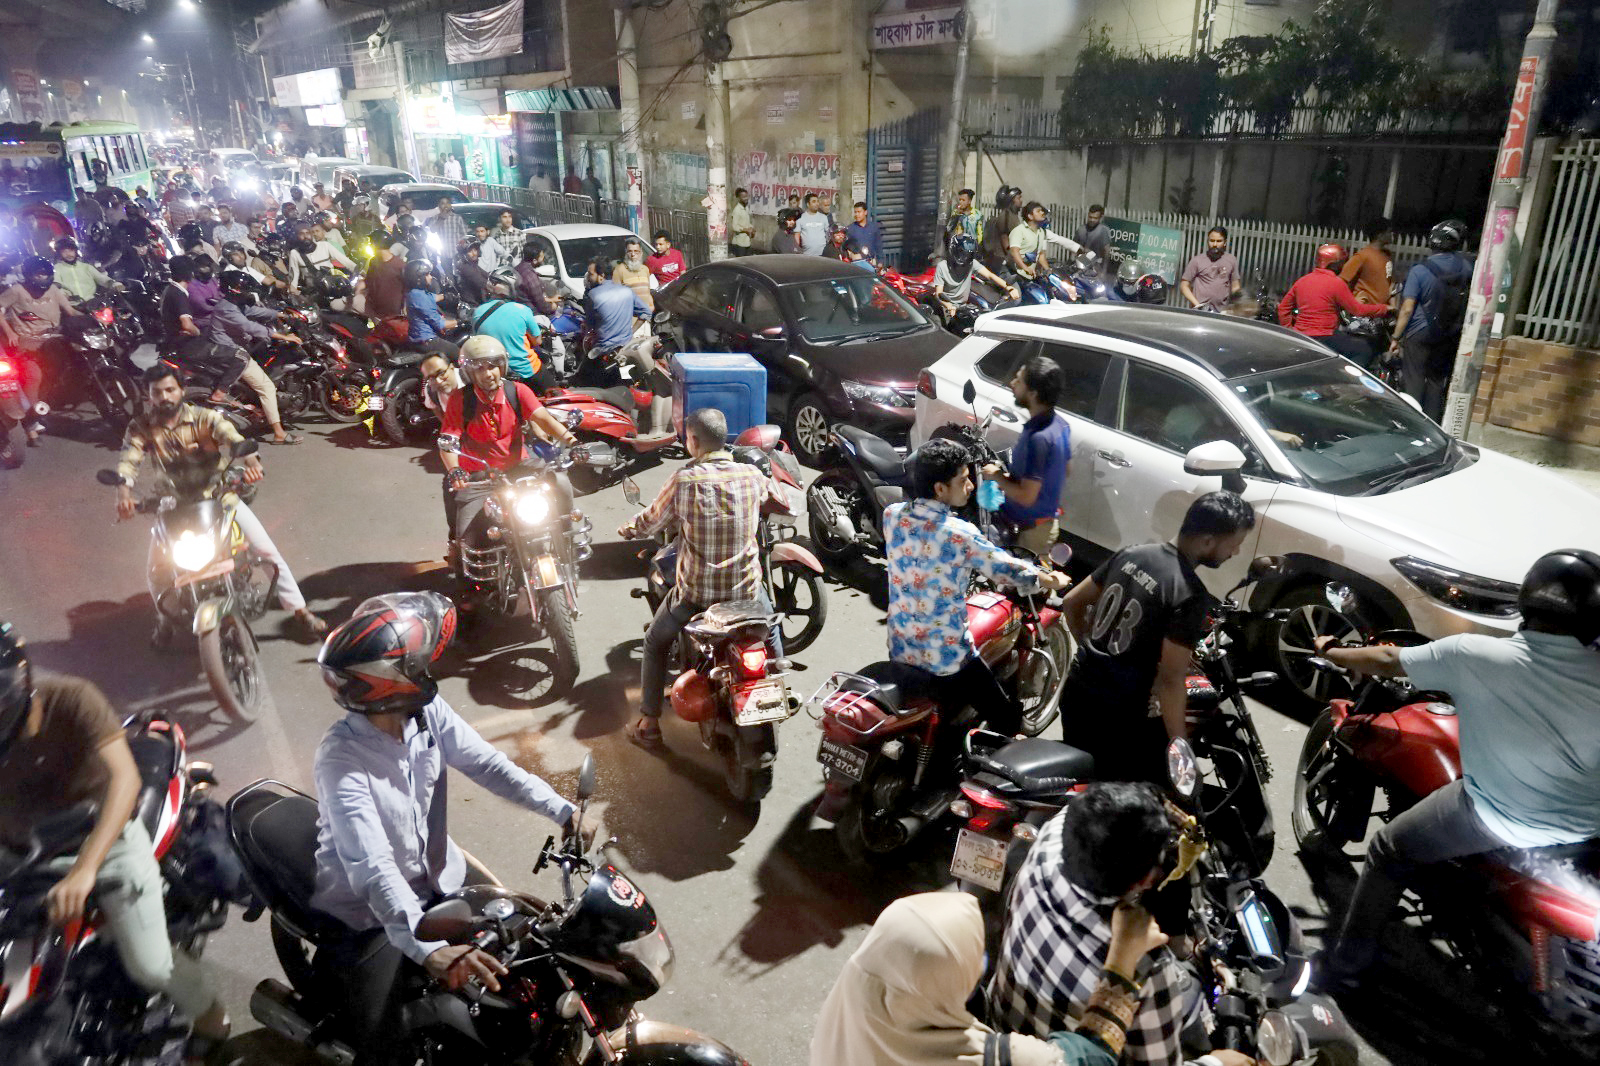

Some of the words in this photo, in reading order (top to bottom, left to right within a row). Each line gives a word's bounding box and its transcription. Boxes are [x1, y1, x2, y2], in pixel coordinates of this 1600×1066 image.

[875, 21, 912, 45] শাহবাগ
[915, 14, 935, 40] চাঁদ
[1139, 233, 1159, 247] 7.00
[1161, 237, 1178, 251] AM
[1092, 582, 1143, 656] 03
[820, 752, 860, 776] 47-3704
